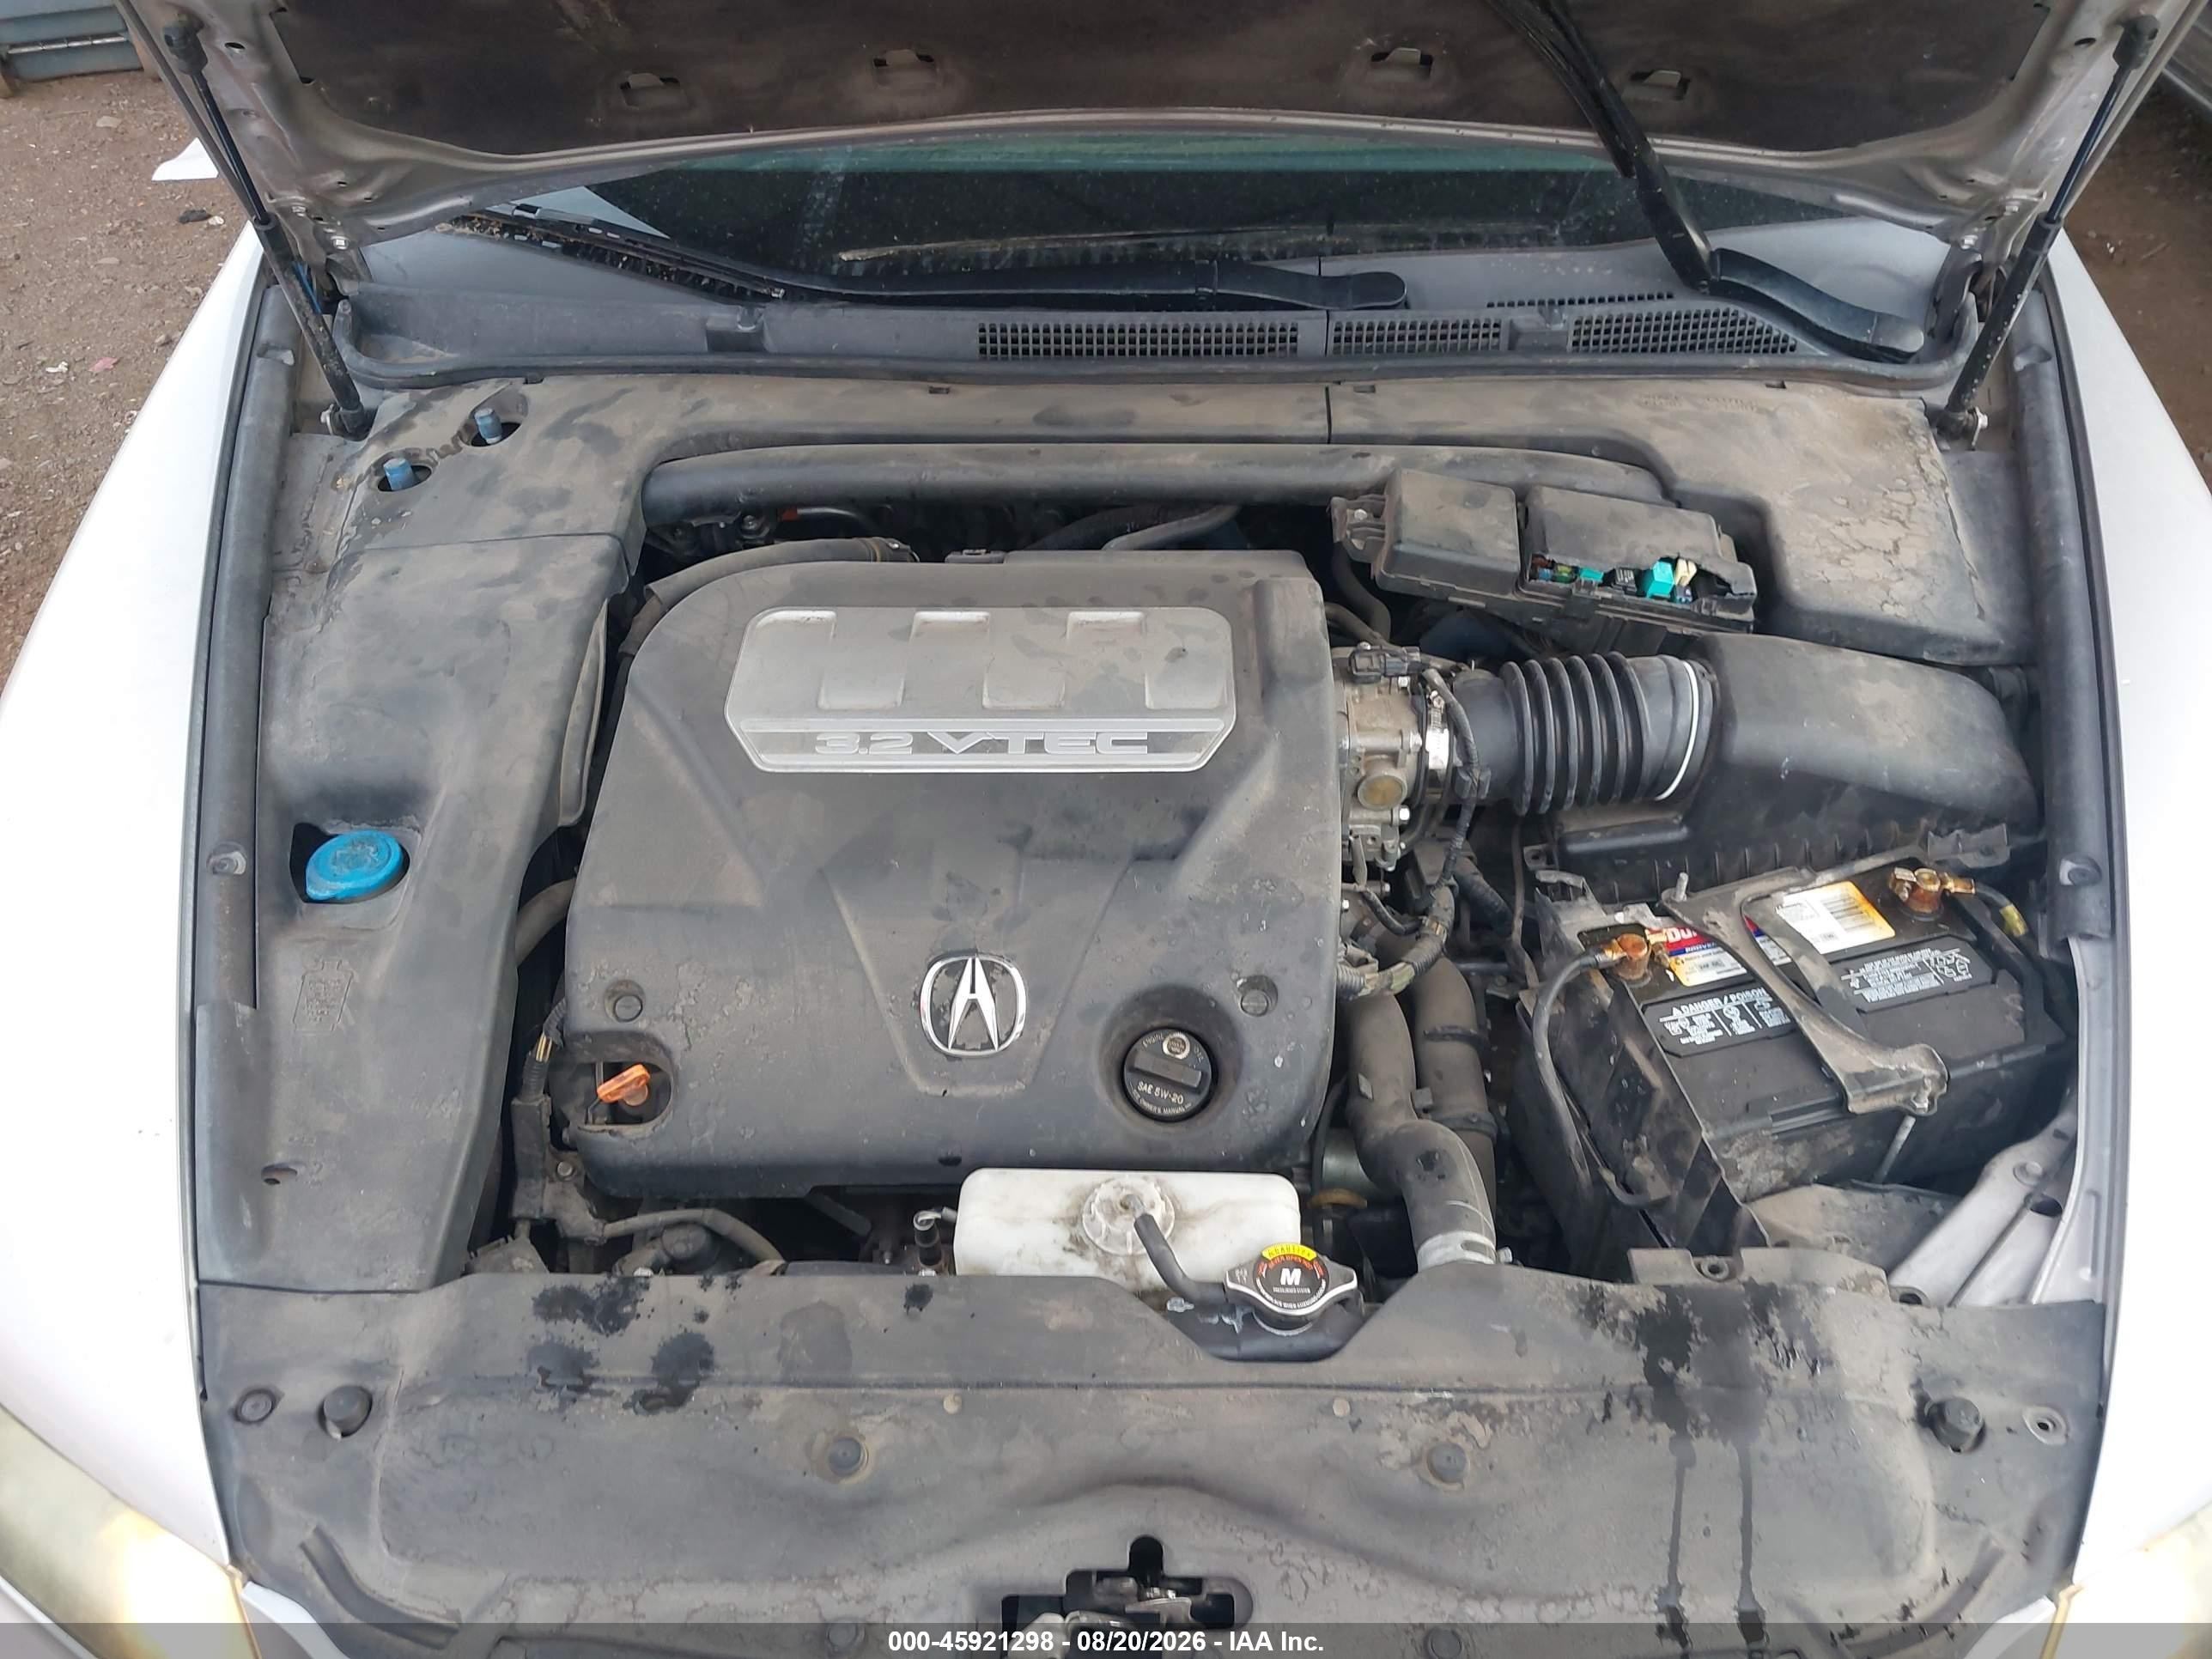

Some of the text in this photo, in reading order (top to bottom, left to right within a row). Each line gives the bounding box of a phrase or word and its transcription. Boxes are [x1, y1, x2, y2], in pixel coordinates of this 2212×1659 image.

[814, 731, 1148, 755] 3.2 VTEC
[1680, 997, 1723, 1014] DANGER
[1729, 988, 1769, 1003] POISON
[1137, 1081, 1154, 1095] SAE
[1279, 1267, 1302, 1286] M
